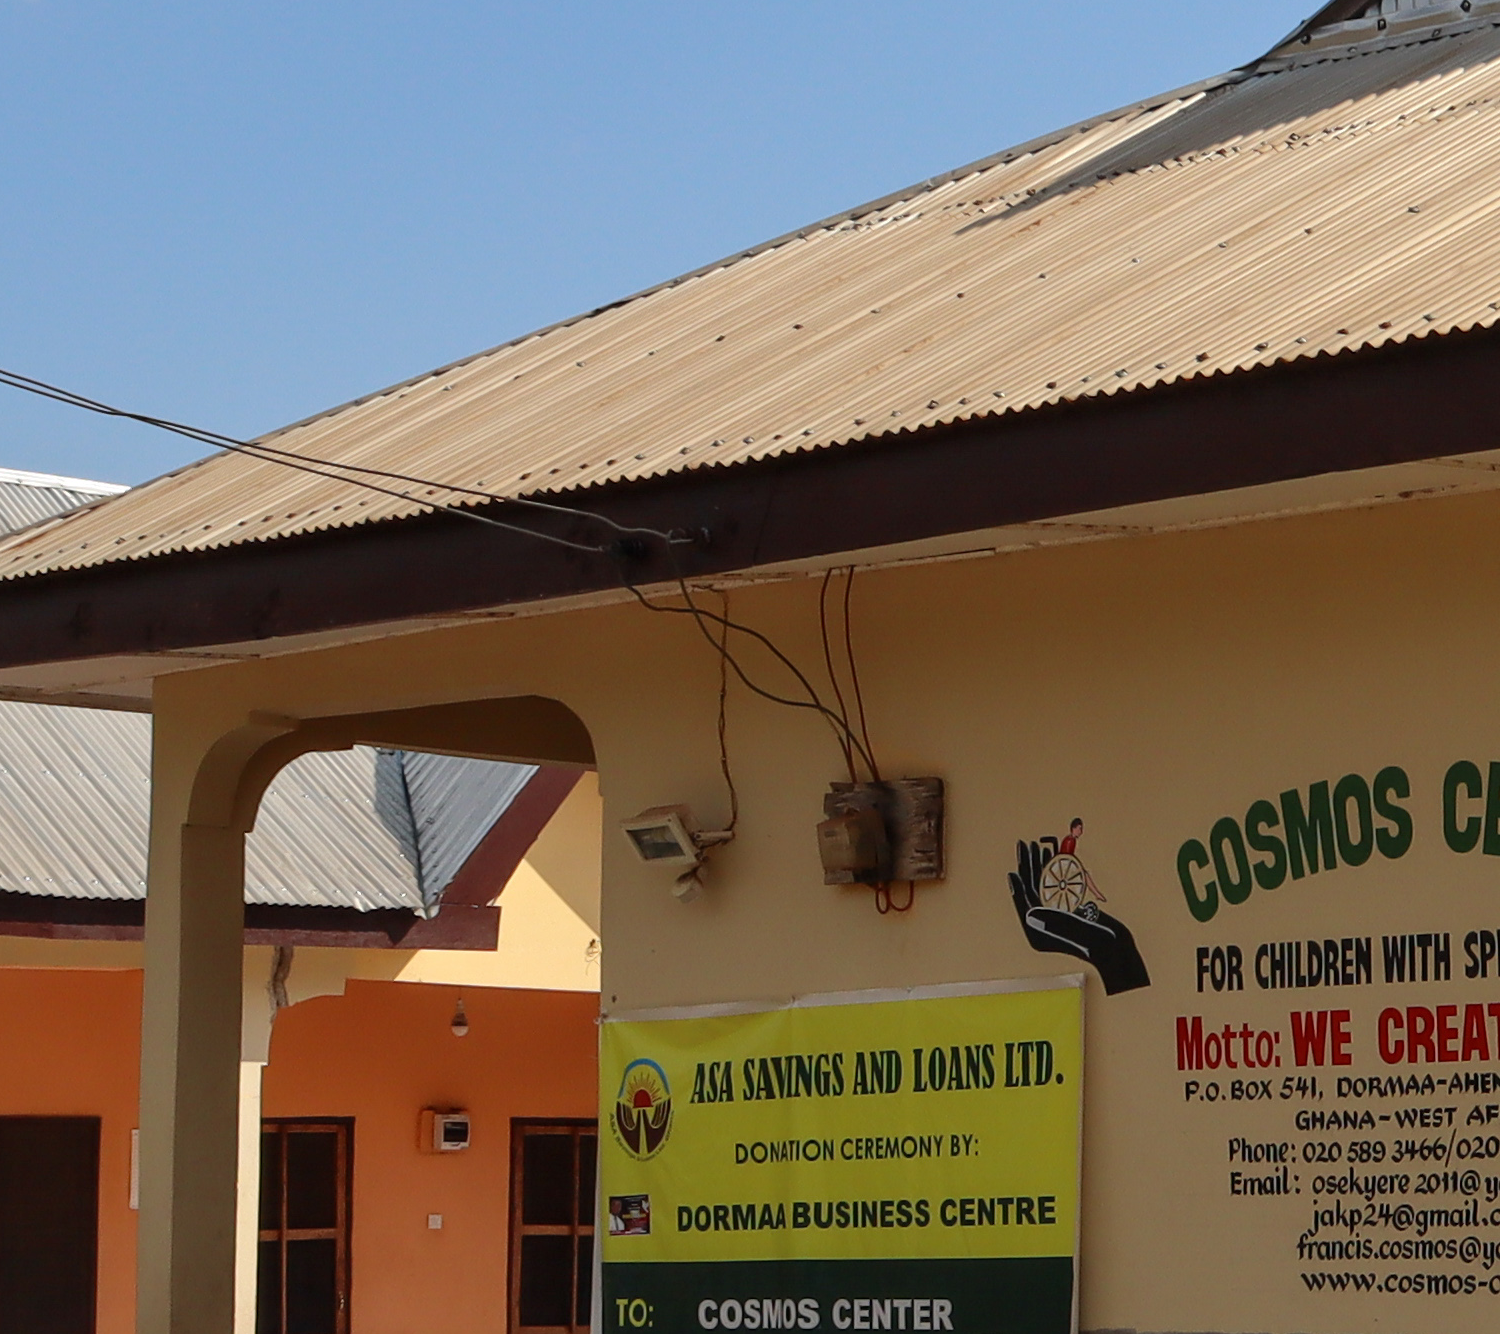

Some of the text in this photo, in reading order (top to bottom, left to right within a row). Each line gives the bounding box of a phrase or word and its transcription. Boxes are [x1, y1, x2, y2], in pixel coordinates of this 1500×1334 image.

[1177, 765, 1413, 923] COSMOS
[1197, 945, 1244, 993] FOR
[1255, 937, 1372, 989] CHILDREN
[1382, 932, 1451, 983] WITH
[1176, 1015, 1281, 1070] Motto:
[1290, 1009, 1352, 1067] WE
[690, 1040, 1065, 1104] ASA SAVINGS AND LOANS LTD.
[1279, 1076, 1324, 1101] 541,
[735, 1134, 980, 1164] DONATION CEREMONY BY:
[1228, 1138, 1297, 1163] Phone:
[1302, 1141, 1342, 1163] 020
[1347, 1140, 1386, 1163] 589
[1230, 1166, 1301, 1196] Email:
[677, 1203, 787, 1232] DORMAA
[791, 1199, 931, 1229] BUSINESS
[939, 1196, 1057, 1227] CENTRE
[616, 1298, 954, 1331] TO: COSMOS CENTER
